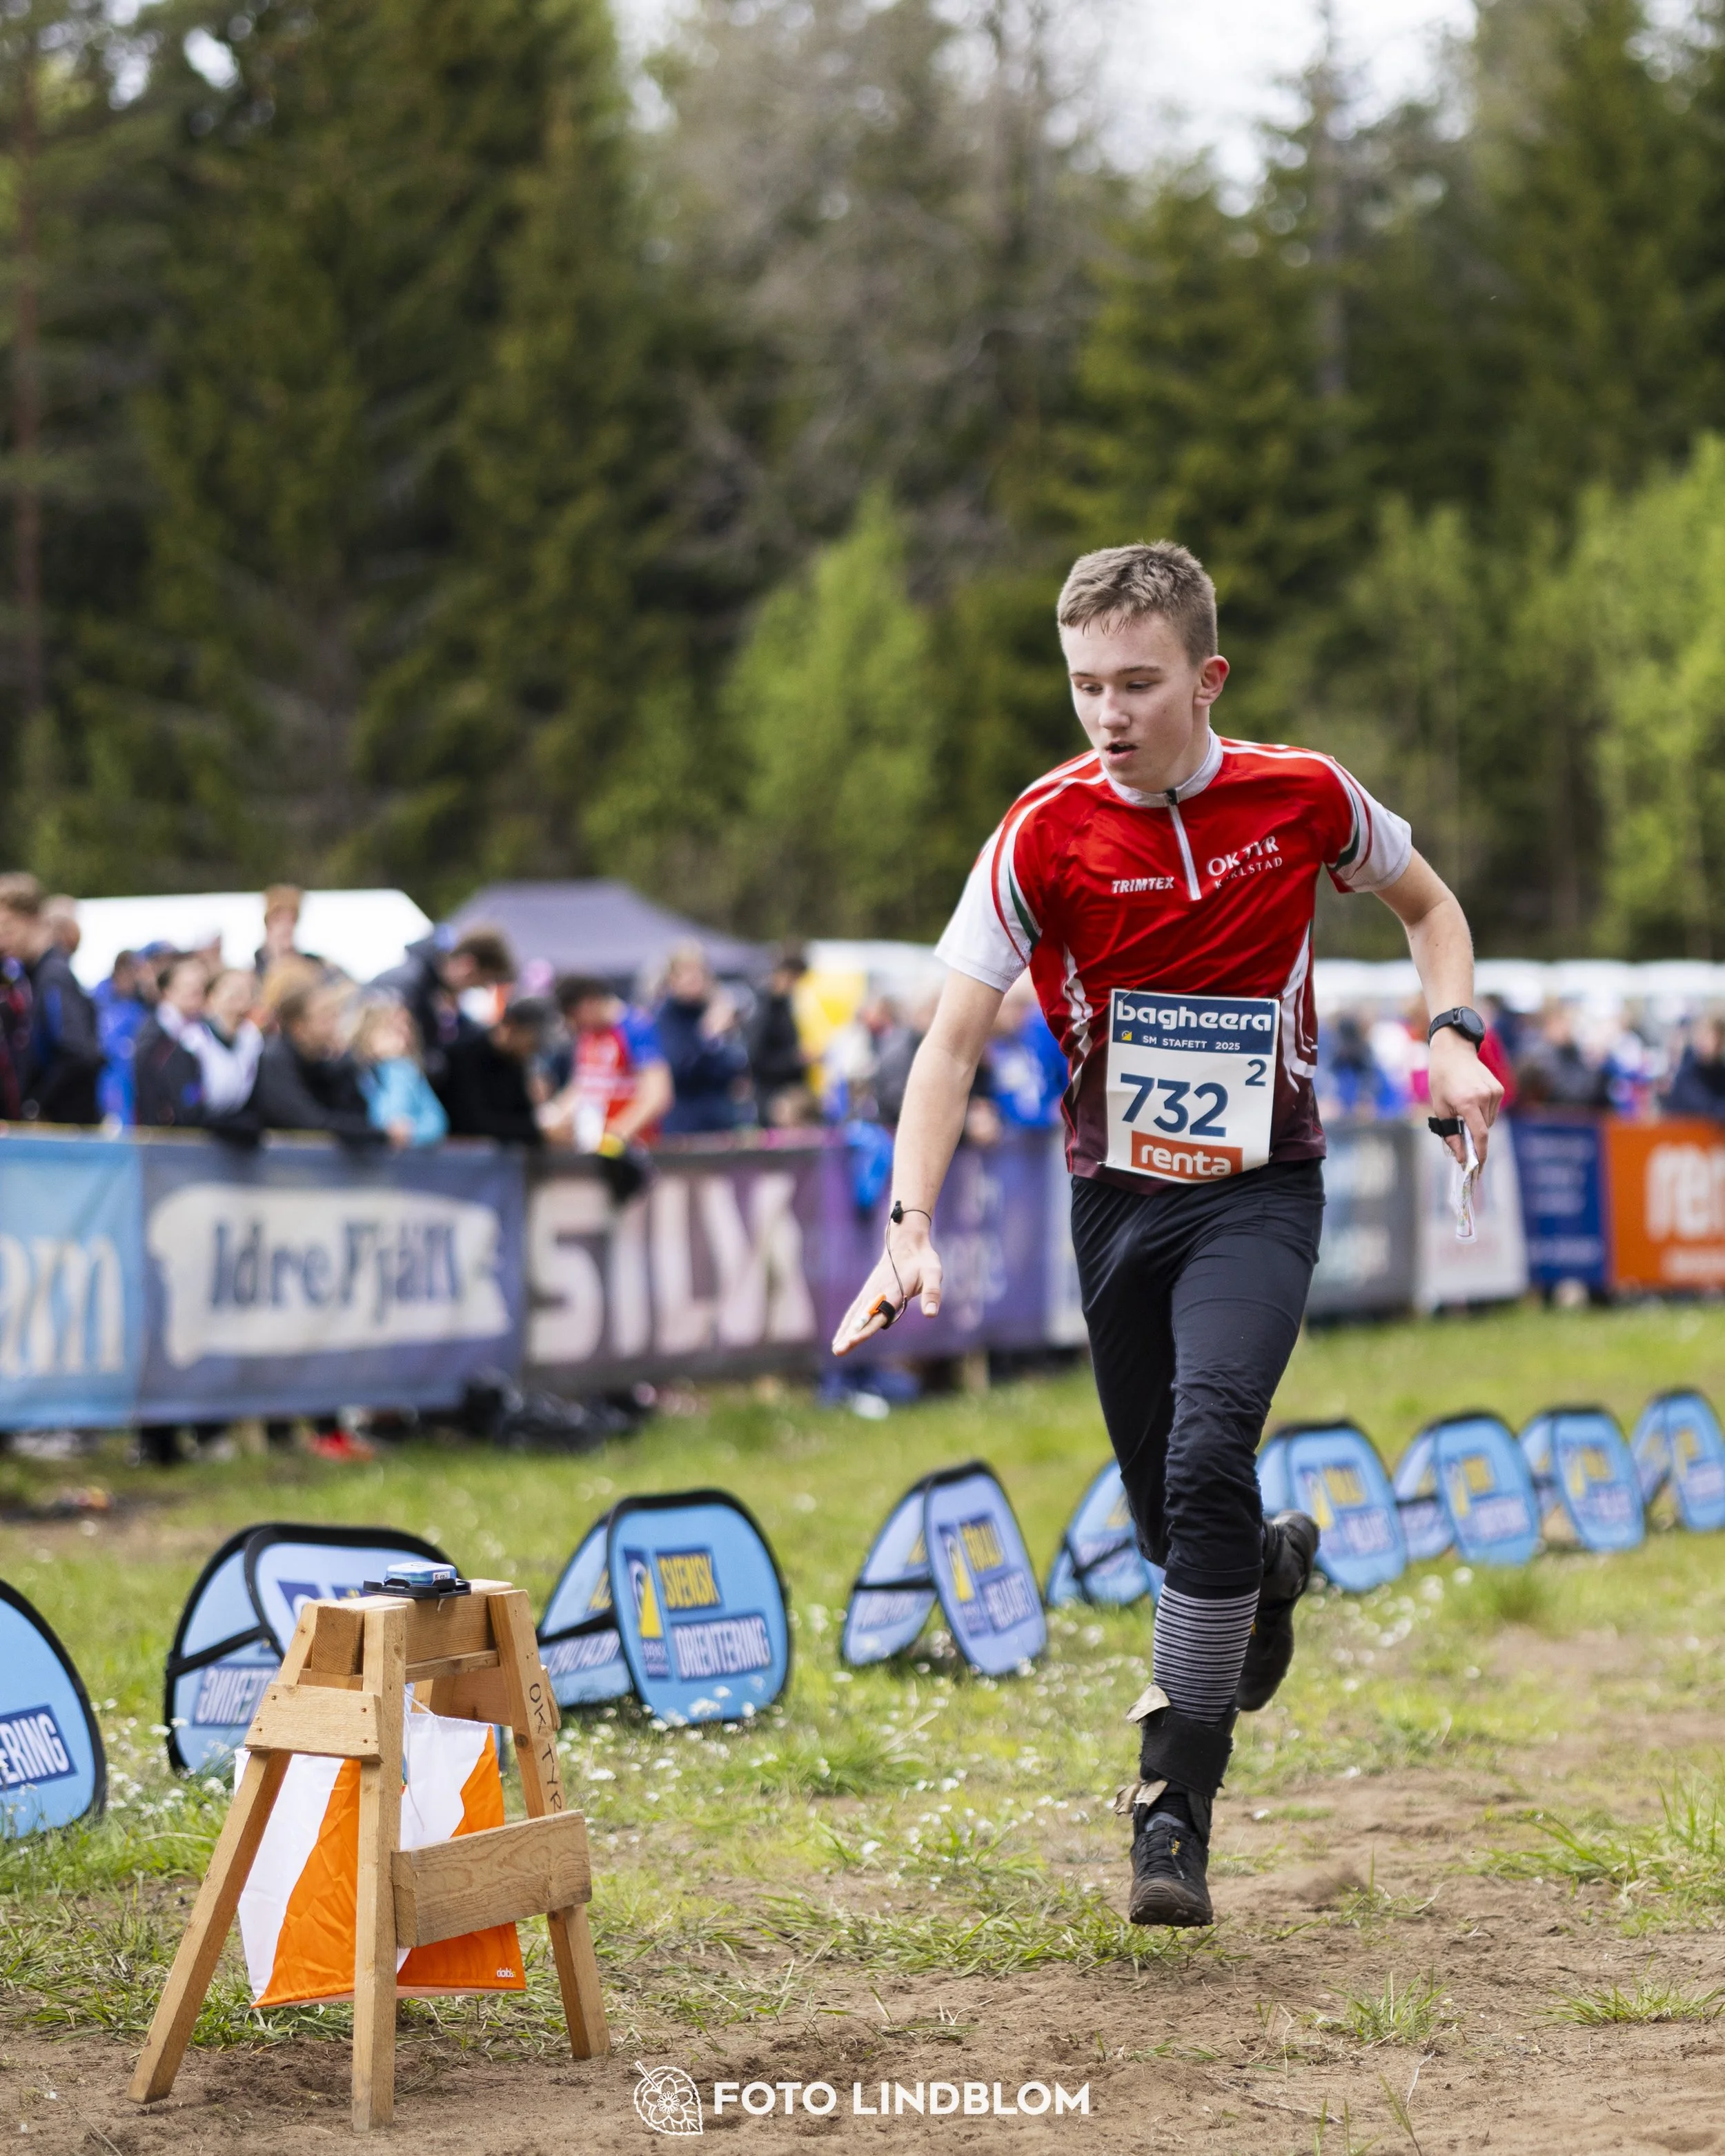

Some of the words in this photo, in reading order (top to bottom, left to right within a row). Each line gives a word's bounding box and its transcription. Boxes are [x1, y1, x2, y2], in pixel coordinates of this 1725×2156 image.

[1208, 852, 1241, 877] OK
[1214, 856, 1283, 890] KRLSTAD
[1112, 876, 1175, 894] TRIMTEX
[1116, 1000, 1272, 1031] bagheera
[1143, 1035, 1157, 1045] SM
[1162, 1038, 1208, 1049] STAFETT
[1215, 1041, 1241, 1051] 2025
[1245, 1058, 1268, 1087] 2
[1120, 1072, 1228, 1138] 732
[1141, 1144, 1232, 1176] renta
[529, 1683, 547, 1734] OK
